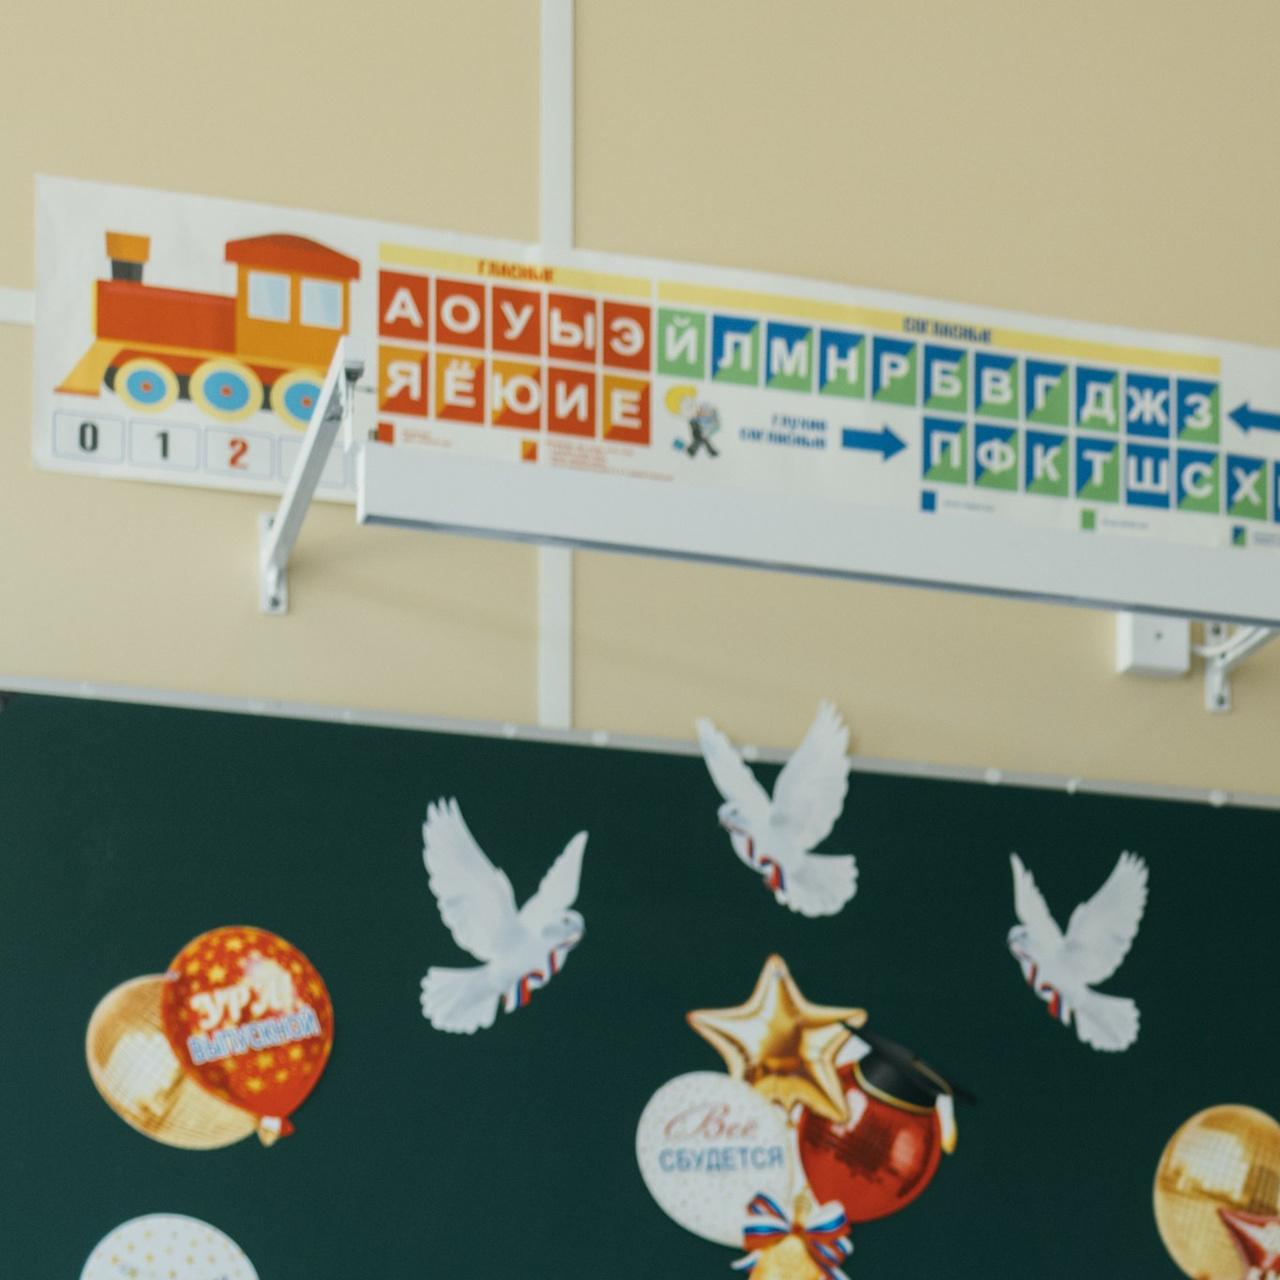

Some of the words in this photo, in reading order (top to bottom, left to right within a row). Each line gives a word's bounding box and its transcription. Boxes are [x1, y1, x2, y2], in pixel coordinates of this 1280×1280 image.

[384, 287, 423, 328] А
[440, 294, 481, 334] О
[500, 301, 534, 340] У
[550, 307, 595, 350] Ы
[610, 317, 645, 356] Э
[386, 360, 422, 401] Я
[444, 360, 477, 408] Ё
[492, 372, 541, 415] Ю
[555, 380, 588, 422] И
[611, 388, 642, 429] Е
[665, 314, 698, 365] Й
[718, 331, 753, 371] Л
[771, 337, 808, 378] М
[826, 344, 858, 384] Н
[880, 351, 910, 389] Р
[931, 359, 962, 397] Б
[981, 367, 1013, 405] В
[1034, 374, 1061, 411] Г
[1081, 381, 1116, 425] Д
[1127, 386, 1169, 426] Ж
[1184, 393, 1212, 430] З
[79, 421, 99, 452] 0
[157, 430, 169, 460] 1
[229, 437, 249, 469] 2
[930, 430, 961, 469] П
[976, 438, 1016, 474] Ф
[1033, 443, 1061, 482] К
[1082, 449, 1112, 487] Т
[1128, 455, 1168, 494] Ш
[1181, 461, 1213, 498] С
[1232, 466, 1262, 506] Х
[187, 1004, 321, 1066] ВЫПУСКНОЙ
[659, 1145, 784, 1174] СБУДЕТСЯ
